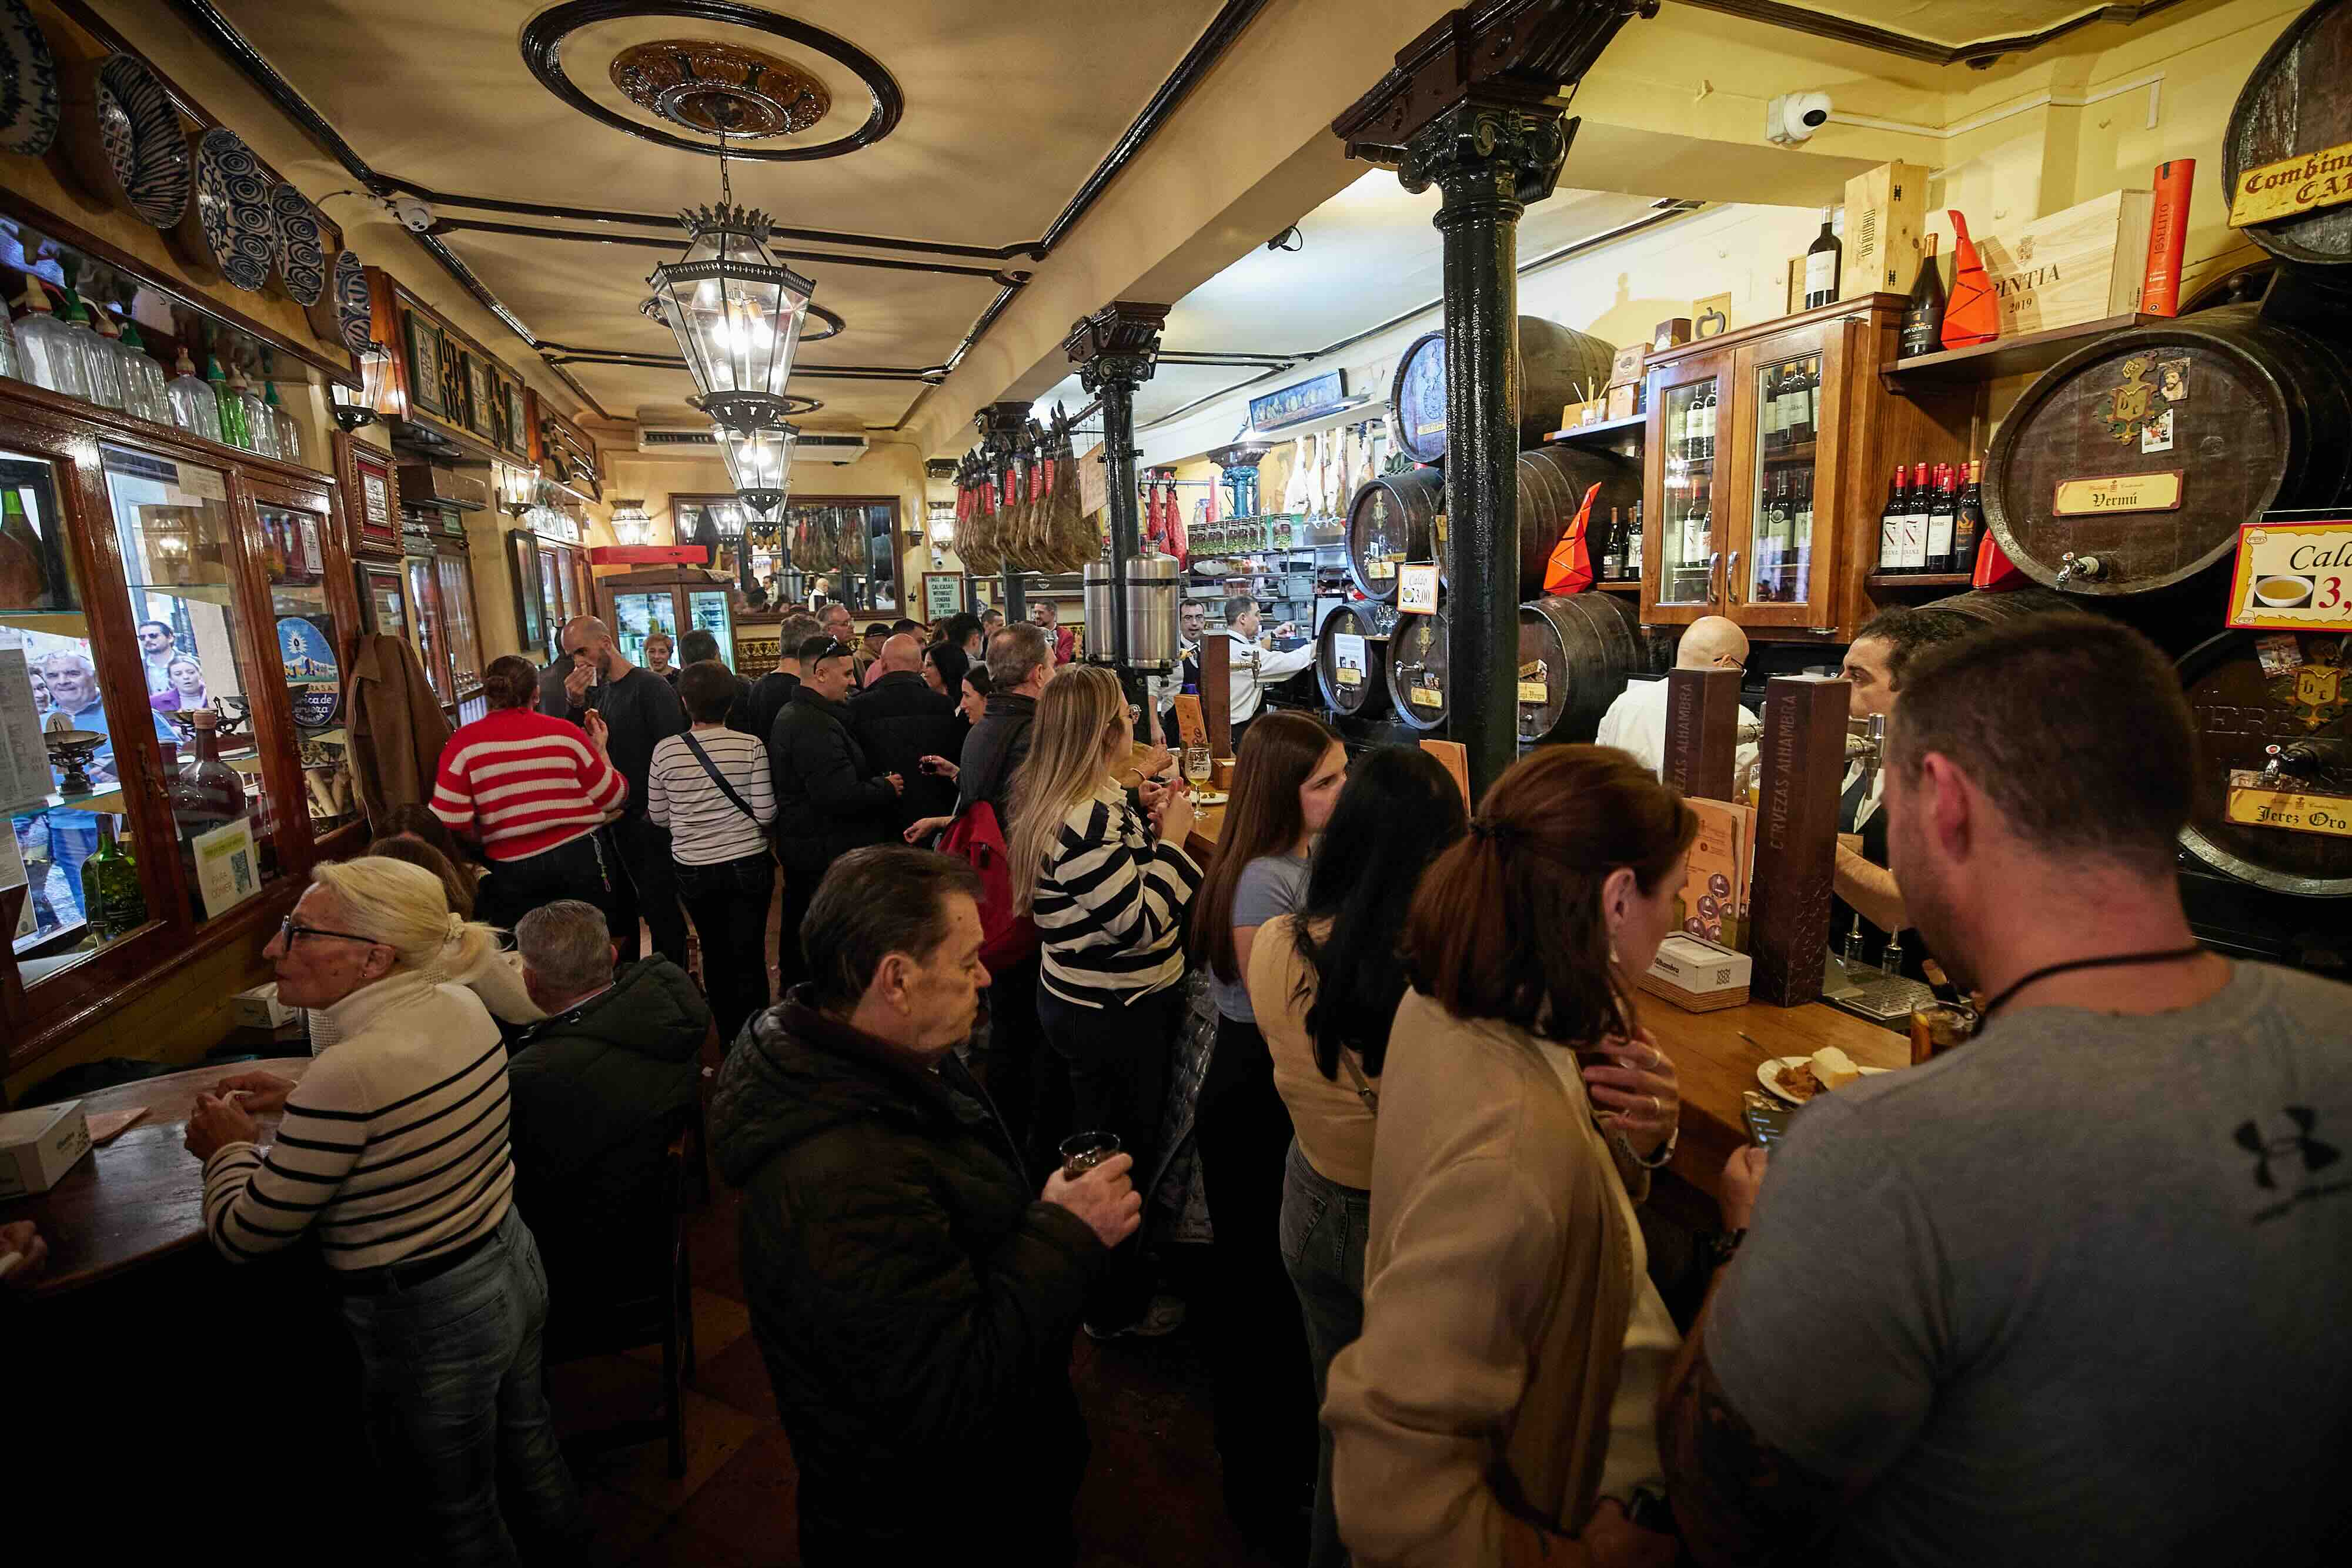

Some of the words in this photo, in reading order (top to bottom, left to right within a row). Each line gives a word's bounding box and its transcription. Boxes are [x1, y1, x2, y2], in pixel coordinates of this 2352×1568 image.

[2245, 153, 2352, 194] Combin
[2009, 297, 2032, 313] 2019
[2093, 492, 2137, 507] Vermú
[1778, 695, 1798, 773] ALHAMBRA
[2309, 812, 2347, 830] Oro
